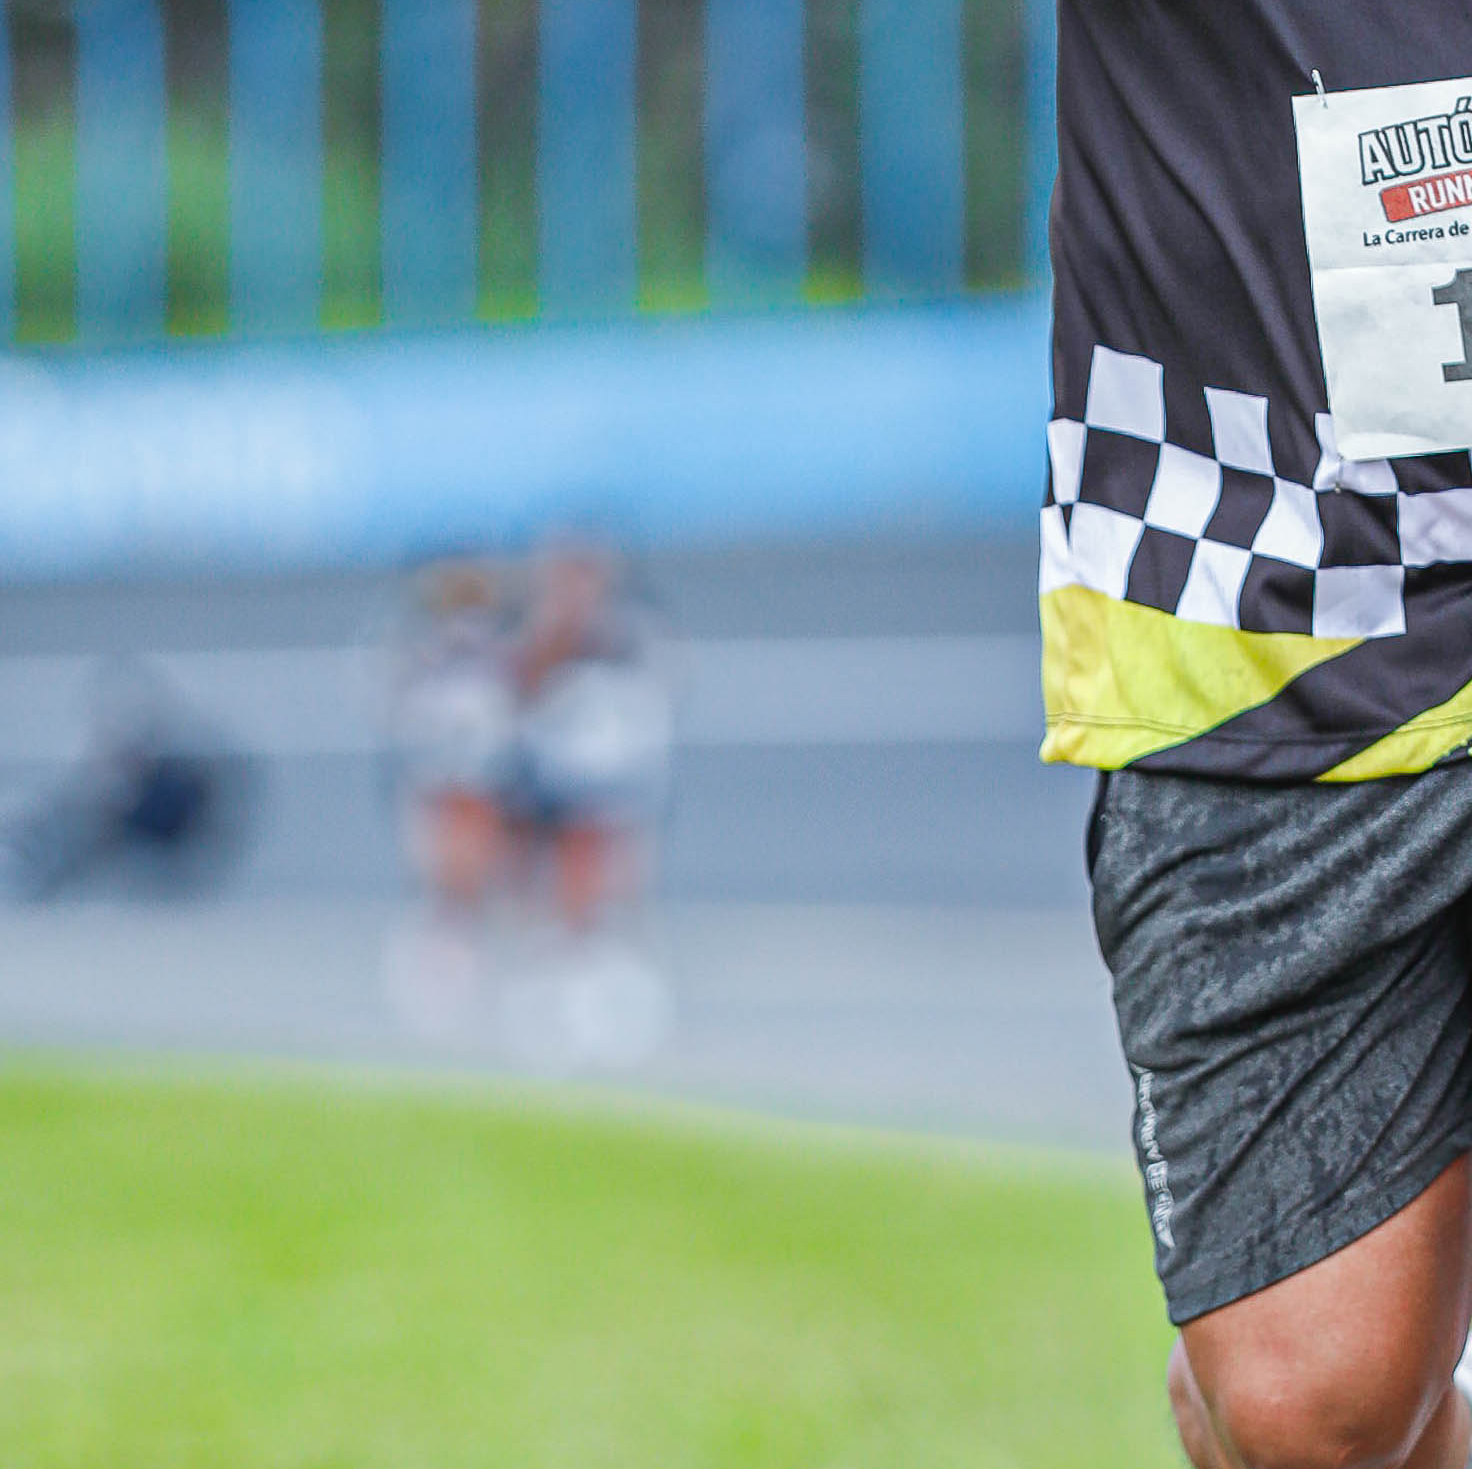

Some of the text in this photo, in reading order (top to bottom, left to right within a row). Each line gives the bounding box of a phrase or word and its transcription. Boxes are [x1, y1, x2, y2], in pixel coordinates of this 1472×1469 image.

[1363, 231, 1381, 246] La
[1385, 226, 1445, 245] Carrera
[1448, 220, 1469, 237] de
